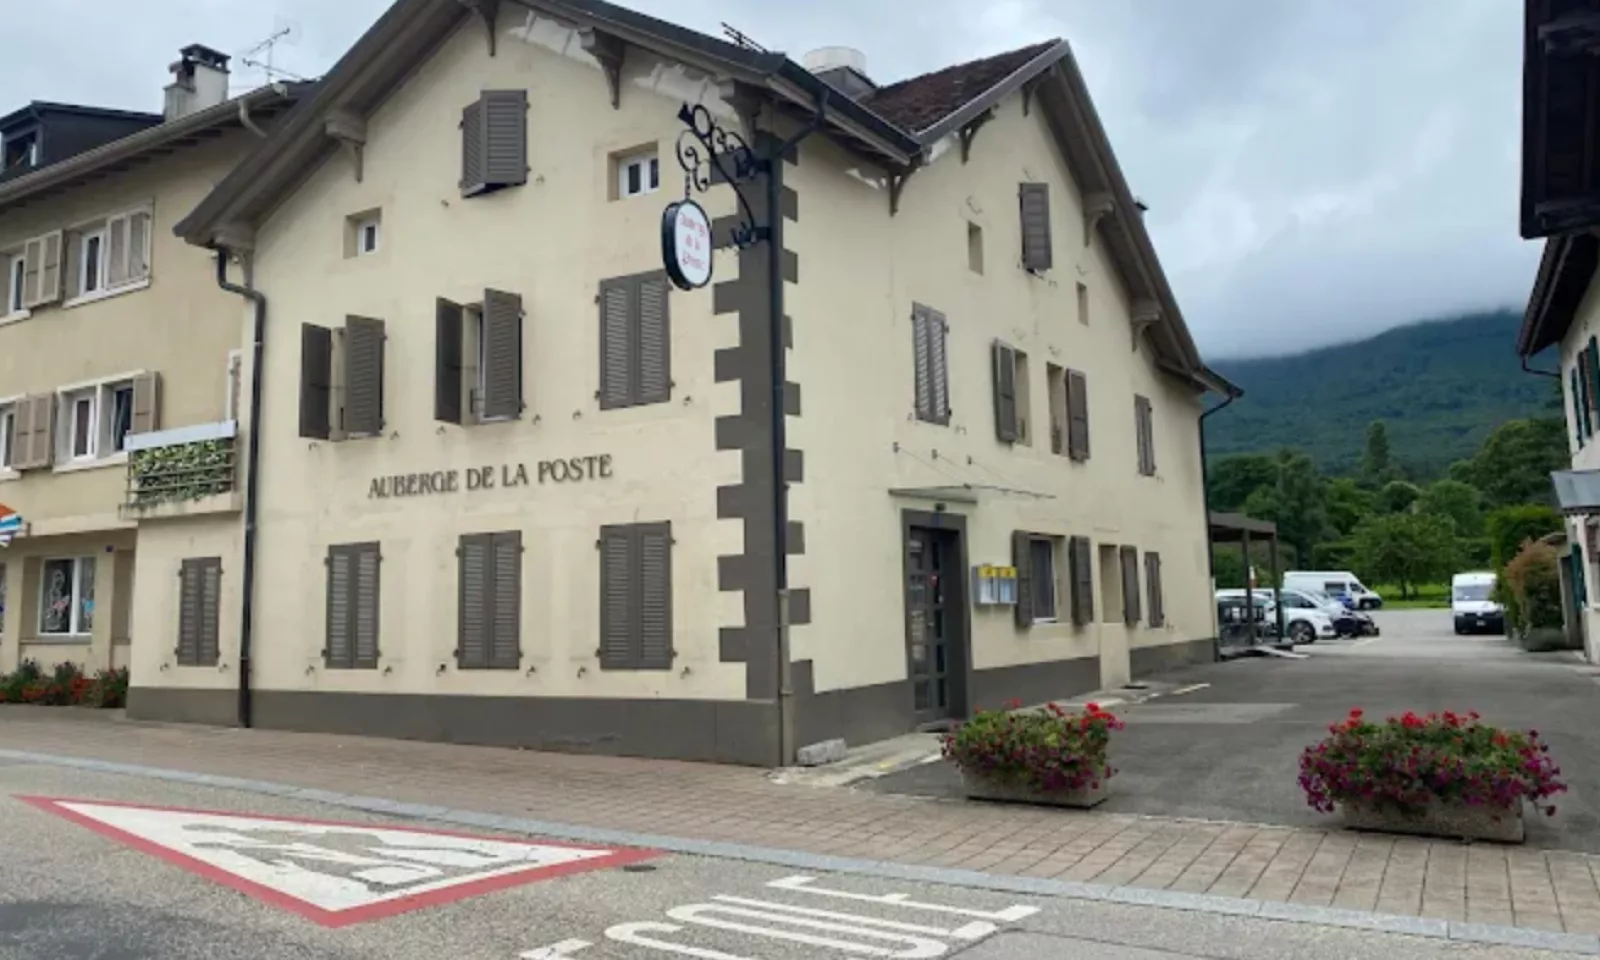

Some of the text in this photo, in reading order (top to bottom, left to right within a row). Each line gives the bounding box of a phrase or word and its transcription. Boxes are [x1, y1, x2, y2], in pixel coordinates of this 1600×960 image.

[368, 453, 612, 499] AUBERGE DE LA POSTE
[519, 875, 1041, 960] COLE
